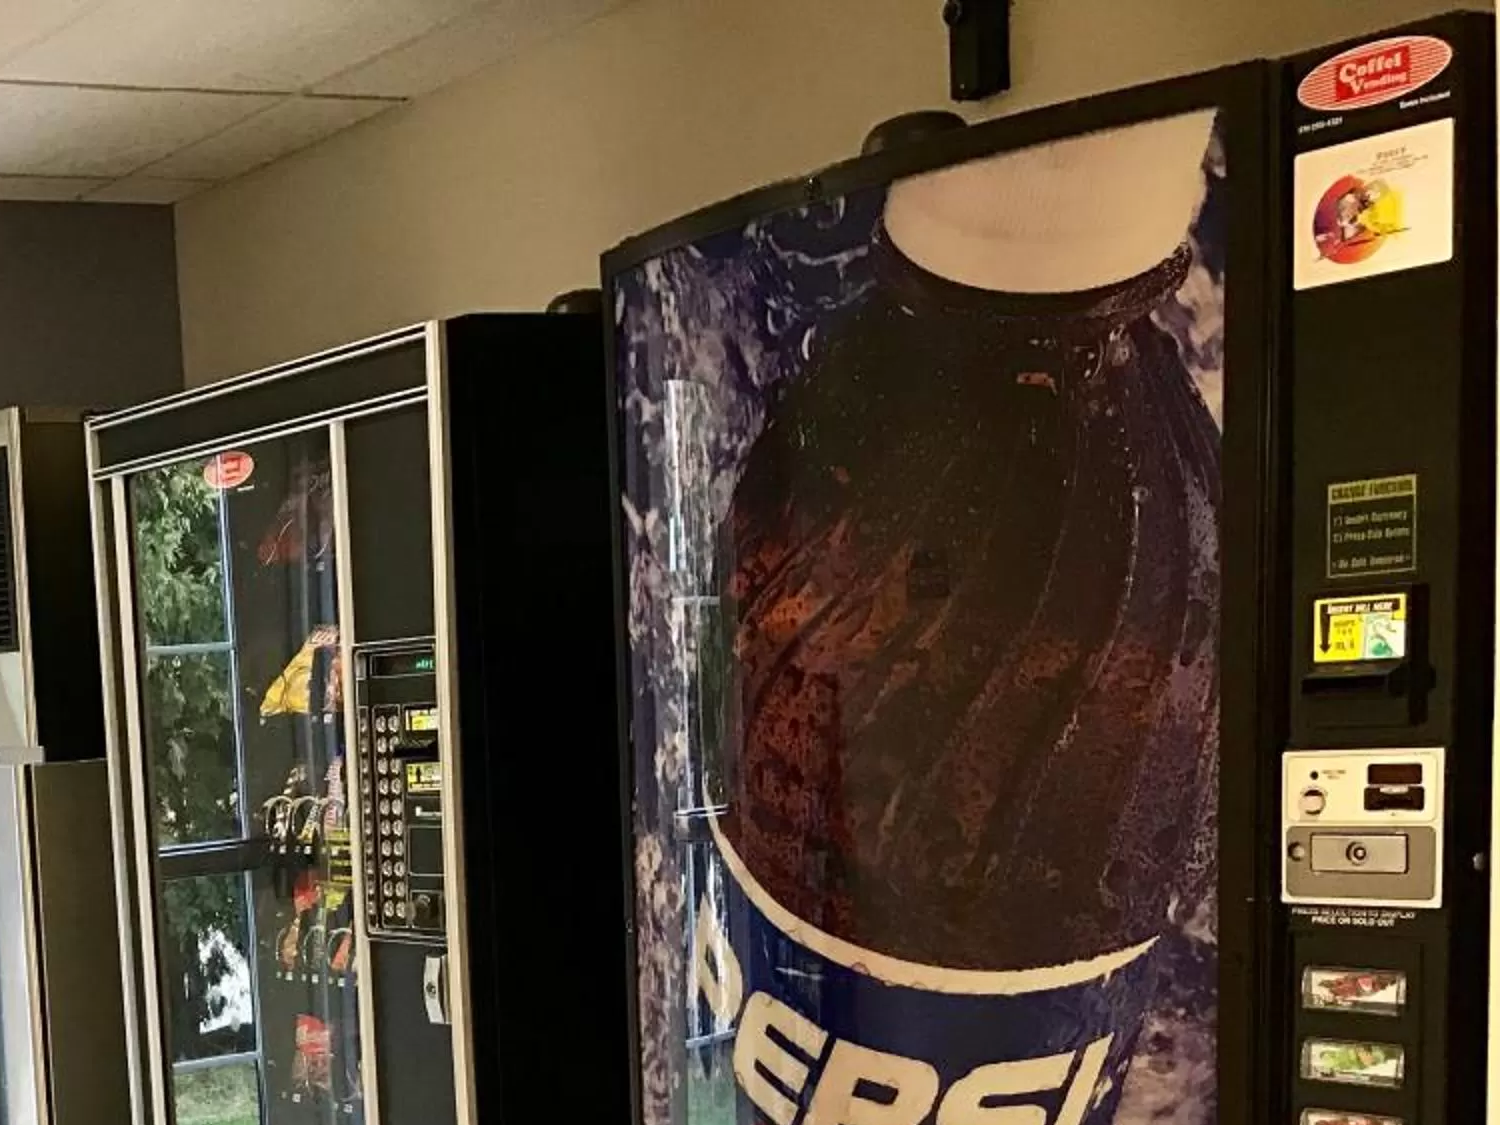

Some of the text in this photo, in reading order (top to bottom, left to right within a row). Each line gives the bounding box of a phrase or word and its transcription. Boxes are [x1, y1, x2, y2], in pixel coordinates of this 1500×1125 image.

[1339, 52, 1402, 84] Coffel
[1350, 71, 1407, 95] Vending
[1312, 915, 1336, 925] PRICE
[1337, 916, 1351, 925] OR
